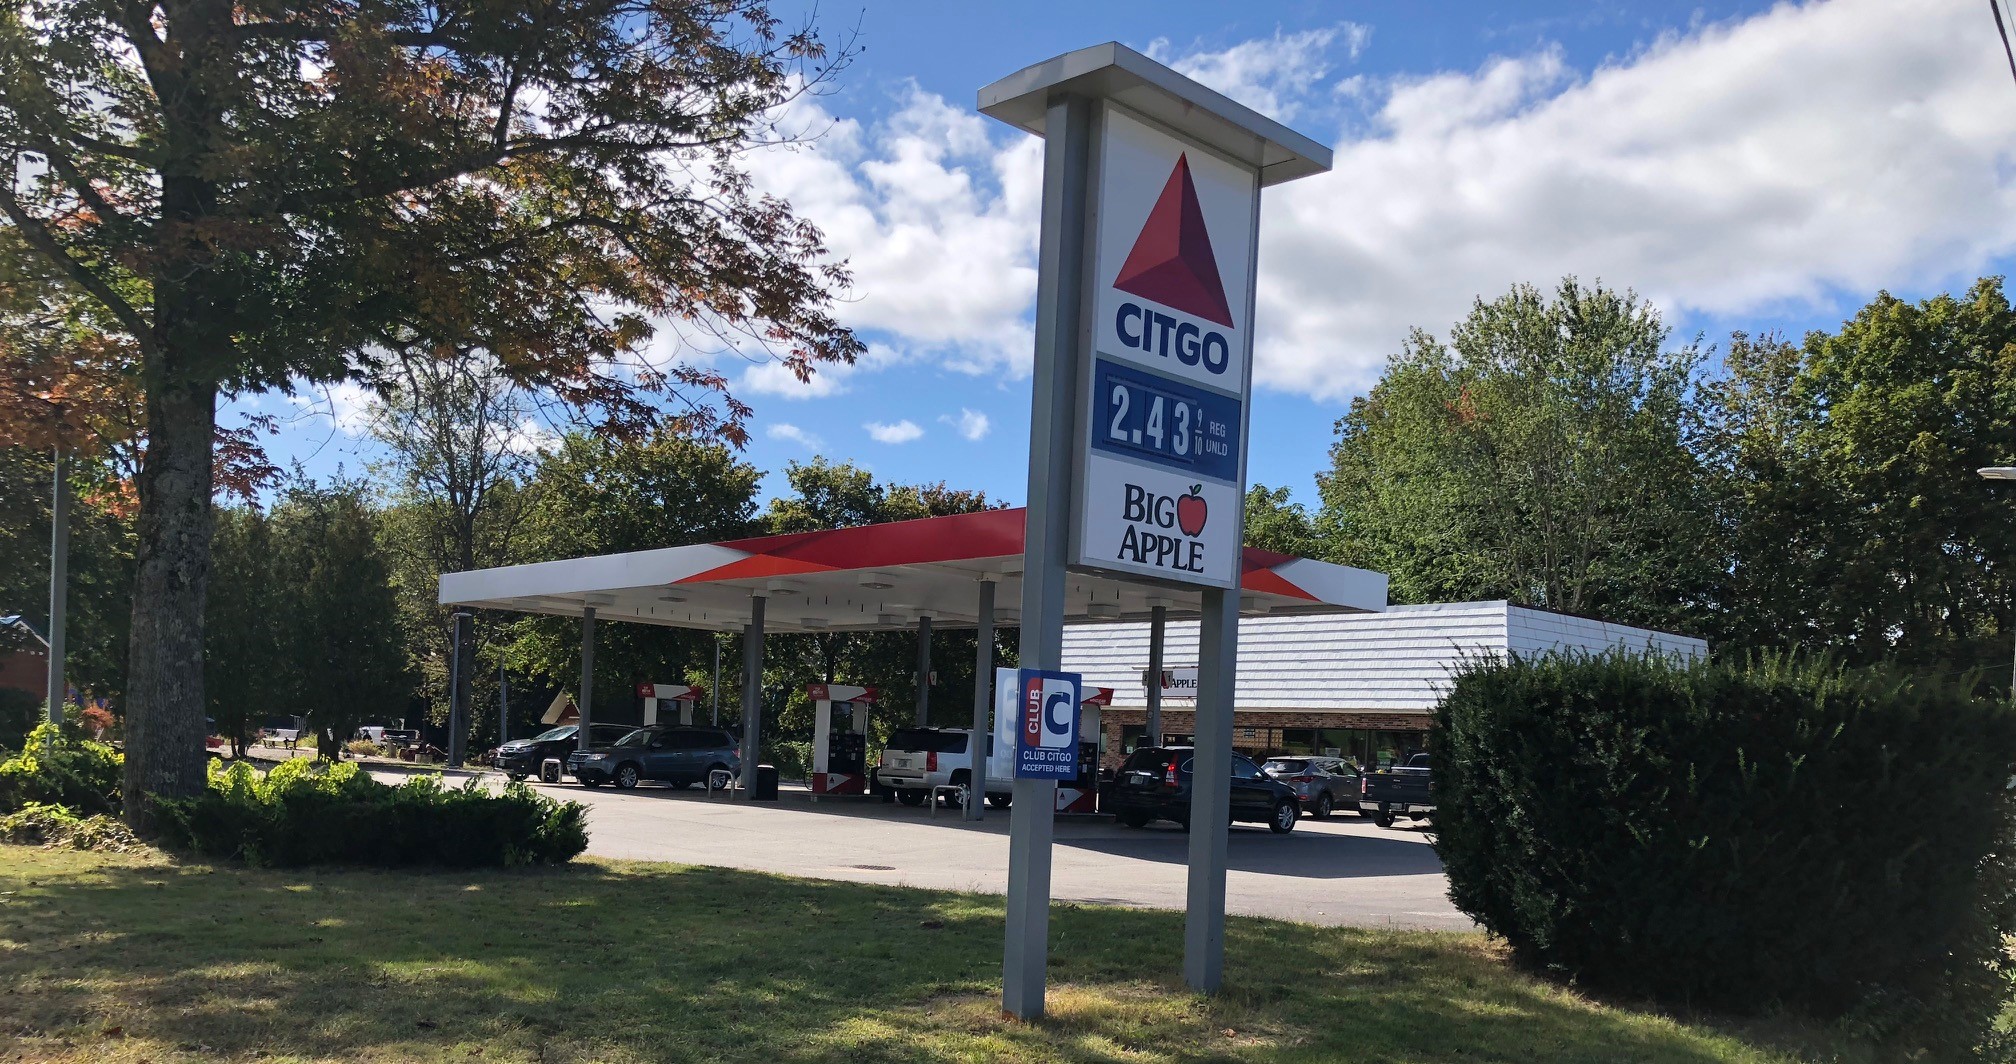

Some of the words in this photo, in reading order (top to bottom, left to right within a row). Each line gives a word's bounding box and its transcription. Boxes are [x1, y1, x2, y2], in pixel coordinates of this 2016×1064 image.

[1116, 303, 1229, 375] CITGO
[1110, 385, 1190, 455] 2.43
[1197, 408, 1203, 428] 9
[1209, 421, 1226, 437] REG
[1194, 436, 1203, 455] 10
[1205, 439, 1228, 457] UNLD
[1122, 483, 1175, 529] BIG
[1117, 524, 1205, 573] APPLE
[1170, 679, 1198, 688] APPLE
[1028, 689, 1040, 734] CLUB
[1045, 691, 1071, 735] C
[1023, 751, 1046, 761] CLUB
[1047, 752, 1072, 762] CITGO
[1022, 764, 1054, 772] ACCEPTED
[1055, 765, 1071, 773] HERE
